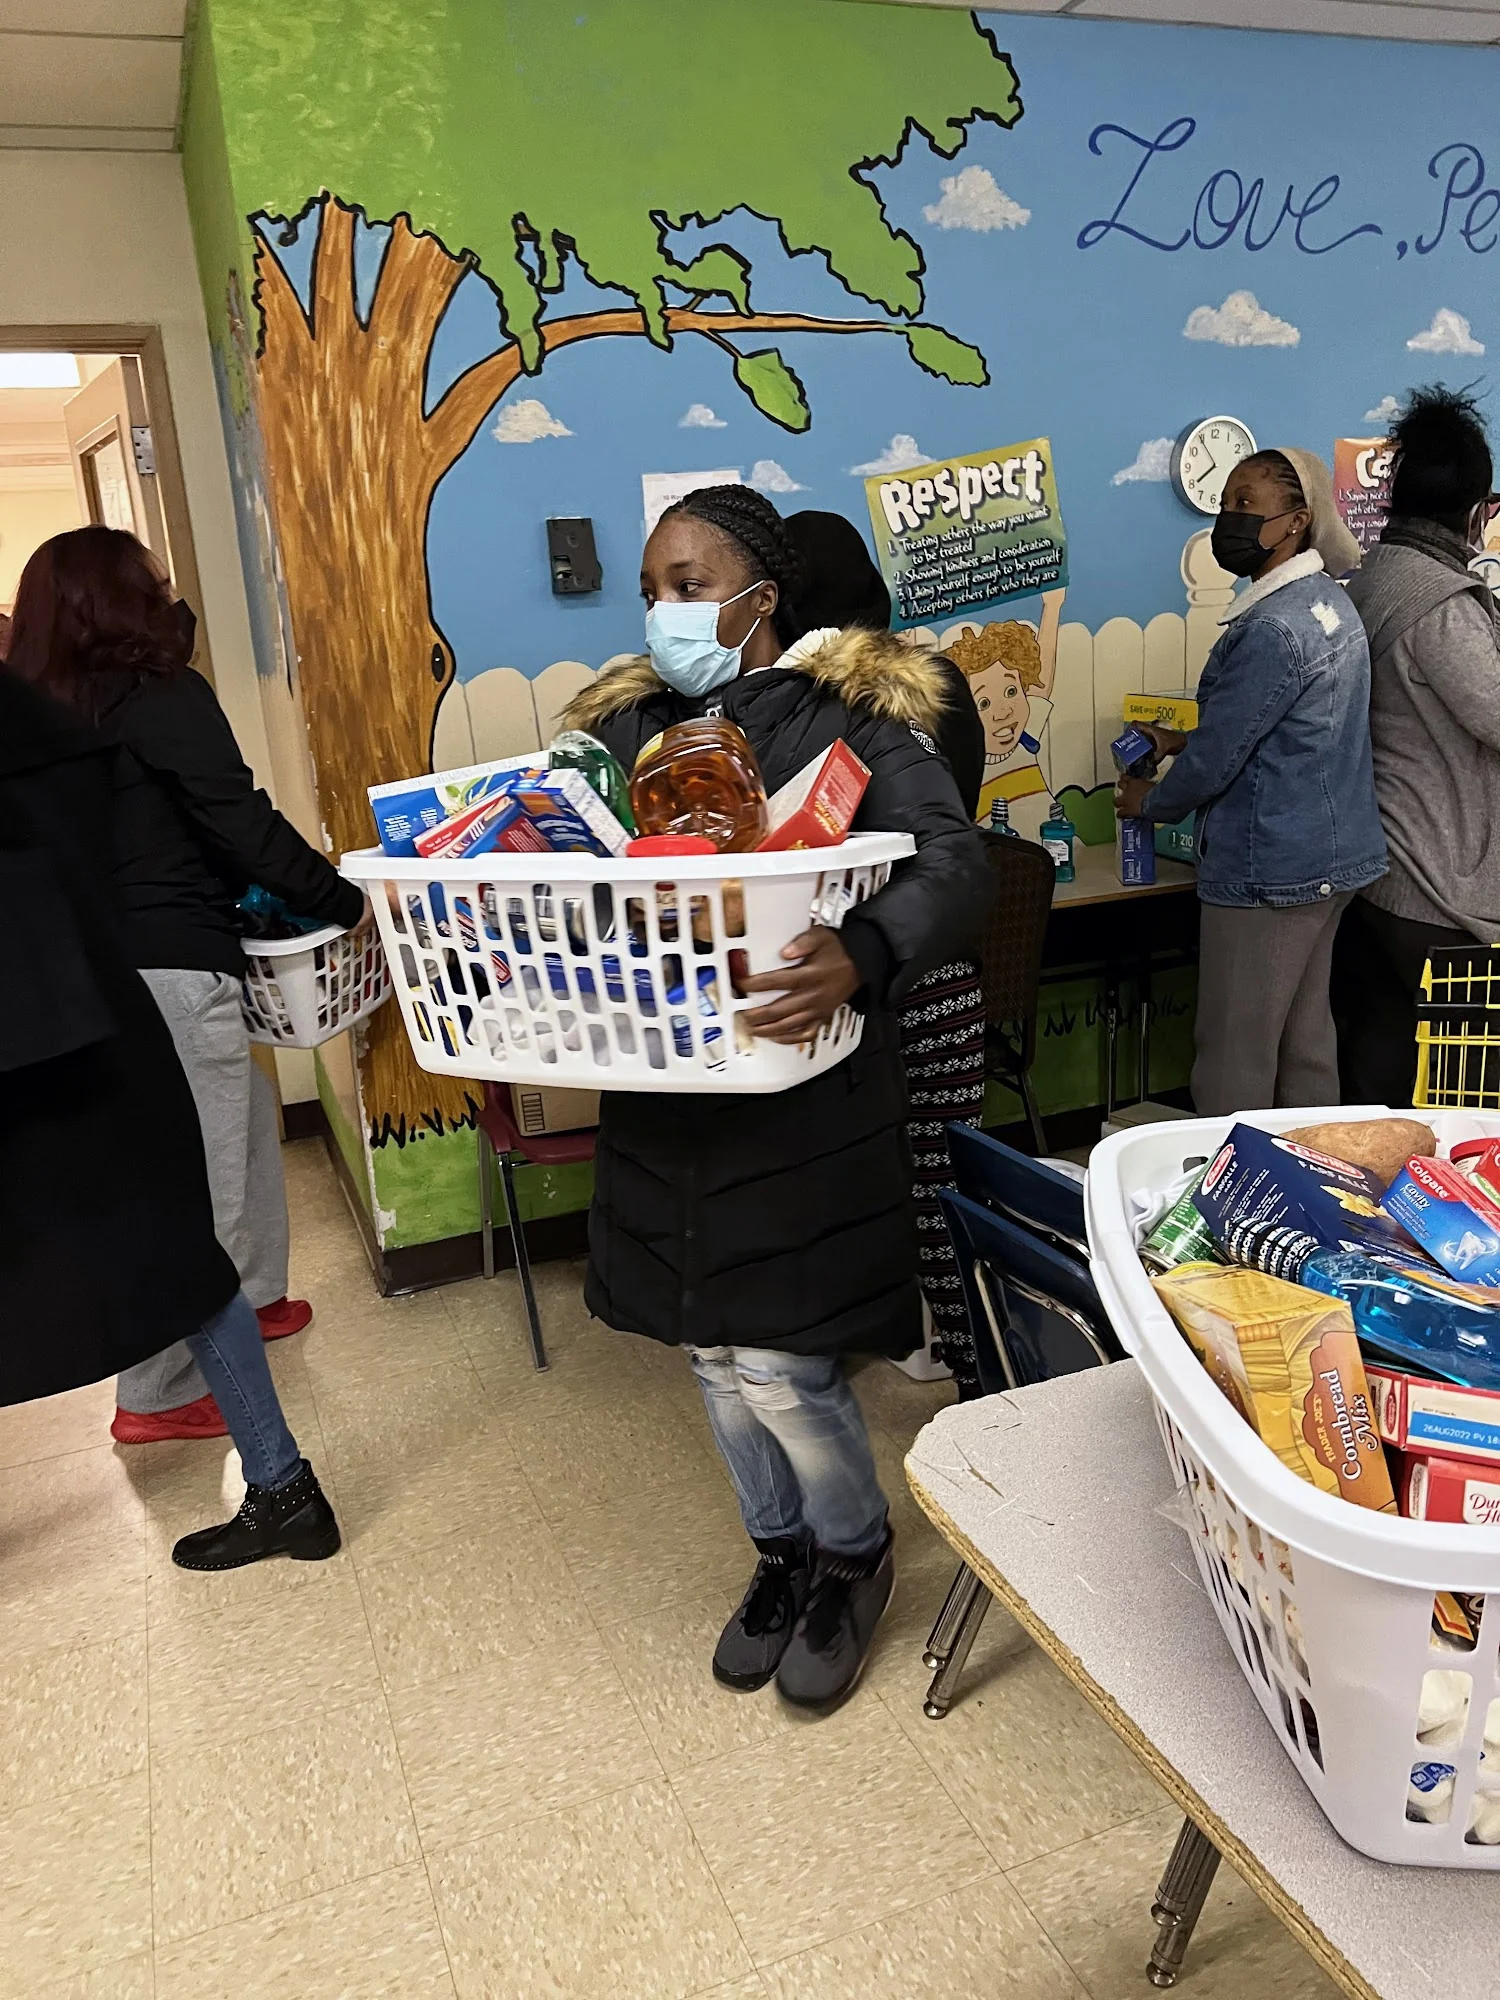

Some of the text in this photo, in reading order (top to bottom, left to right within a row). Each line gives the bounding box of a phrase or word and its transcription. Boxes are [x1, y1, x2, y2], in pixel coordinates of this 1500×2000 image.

[1211, 428, 1220, 440] 12
[1234, 443, 1241, 454] 2
[1184, 462, 1192, 473] 9
[1189, 446, 1198, 457] 10
[879, 450, 1044, 534] Respect
[1188, 479, 1195, 489] 8
[1197, 490, 1204, 501] 7
[1210, 494, 1217, 504] 6
[887, 507, 1049, 554] 1. Treating others the way you want
[893, 538, 1052, 585] 2. Showing kindness and consideration
[912, 537, 973, 565] to be treated
[896, 548, 1062, 601] 3. Liking yourself enough to be yourself
[899, 570, 1058, 618] 4. Accepting others for who they are
[1212, 1160, 1239, 1201] FARFALLE
[1404, 1182, 1431, 1209] Cavity
[1408, 1159, 1448, 1199] Colgate
[1312, 1392, 1336, 1463] TRADER JOE'S
[1319, 1368, 1362, 1481] Cornbread
[1349, 1393, 1379, 1451] Mix
[1473, 1432, 1485, 1442] PV
